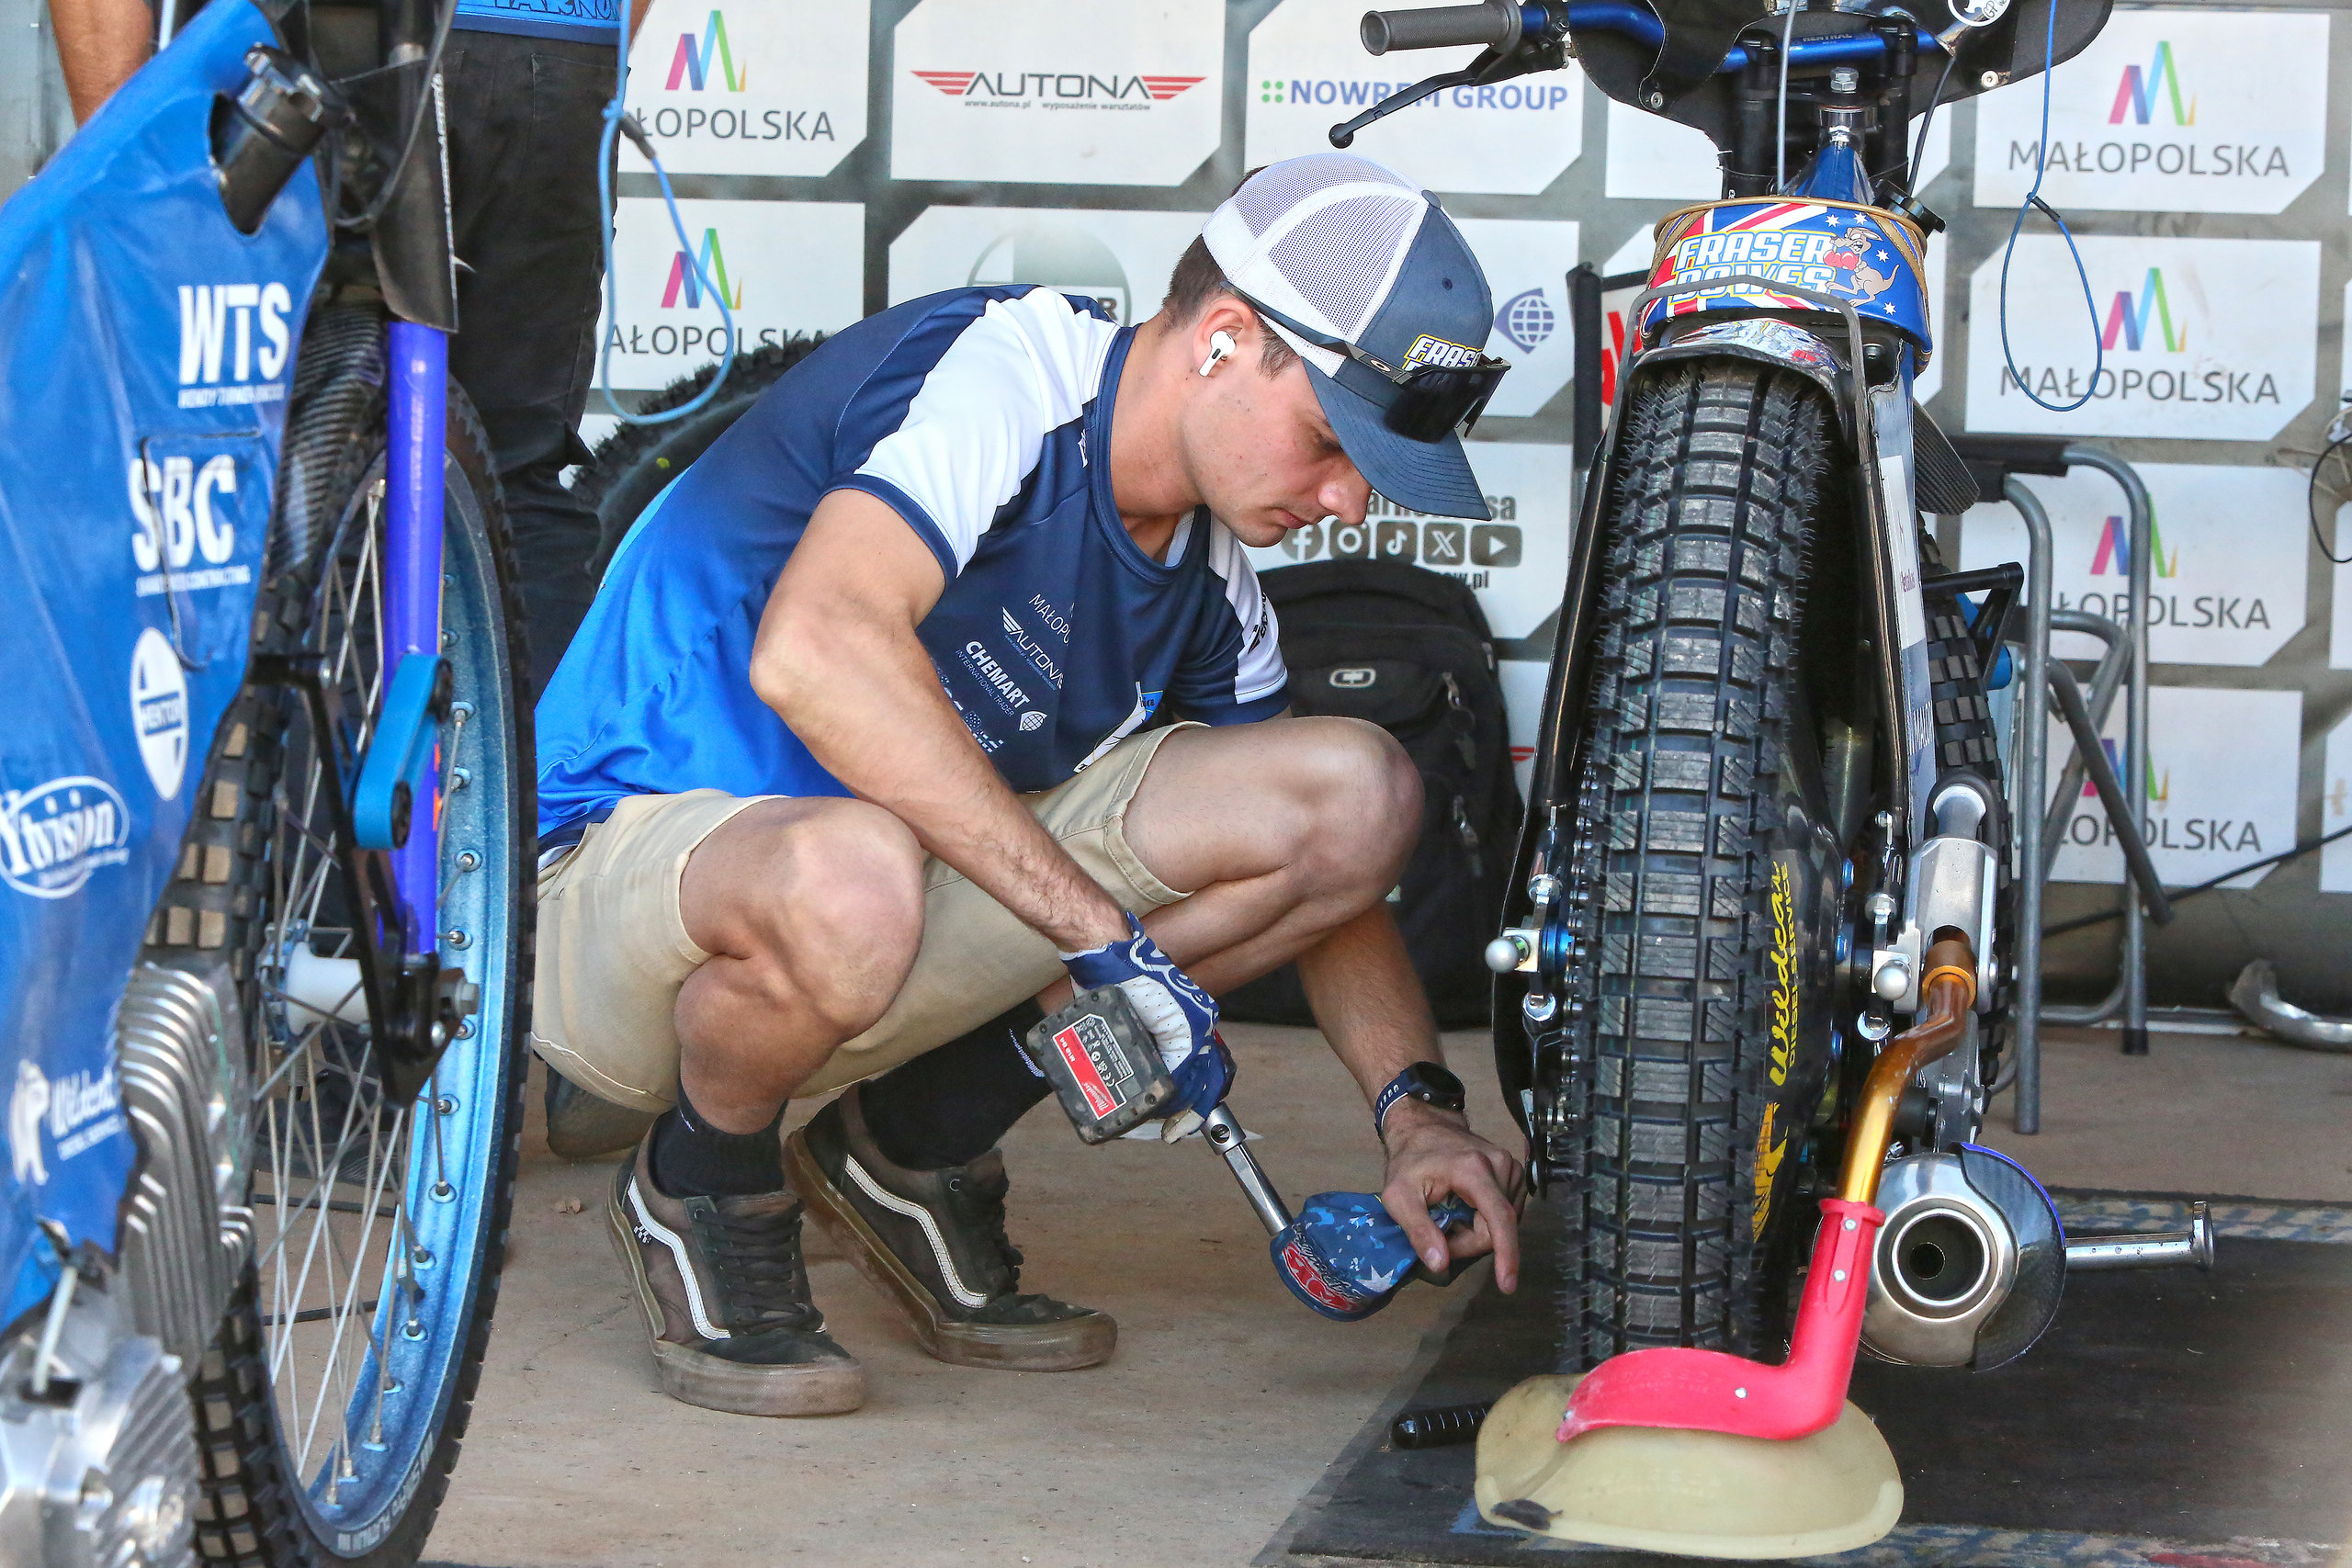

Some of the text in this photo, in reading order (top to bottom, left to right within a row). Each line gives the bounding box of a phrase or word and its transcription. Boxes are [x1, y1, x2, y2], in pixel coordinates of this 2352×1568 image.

[964, 99, 1032, 109] www.autona.pl
[966, 72, 1151, 99] AUTONA
[1452, 83, 1568, 110] GROUP
[636, 107, 835, 141] ŁOPOLSKA
[2008, 140, 2290, 177] MAŁOPOLSKA
[1674, 230, 1835, 273] FRASER
[178, 281, 291, 385] WTS
[1999, 367, 2281, 405] MAŁOPOLSKA
[128, 454, 237, 572] SBC
[966, 641, 1031, 709] CHEMART
[1010, 629, 1064, 690] AUTONA
[956, 649, 995, 697] INTERNATIONAL
[993, 694, 1015, 717] TRADER
[1781, 862, 1798, 975] SERVICE
